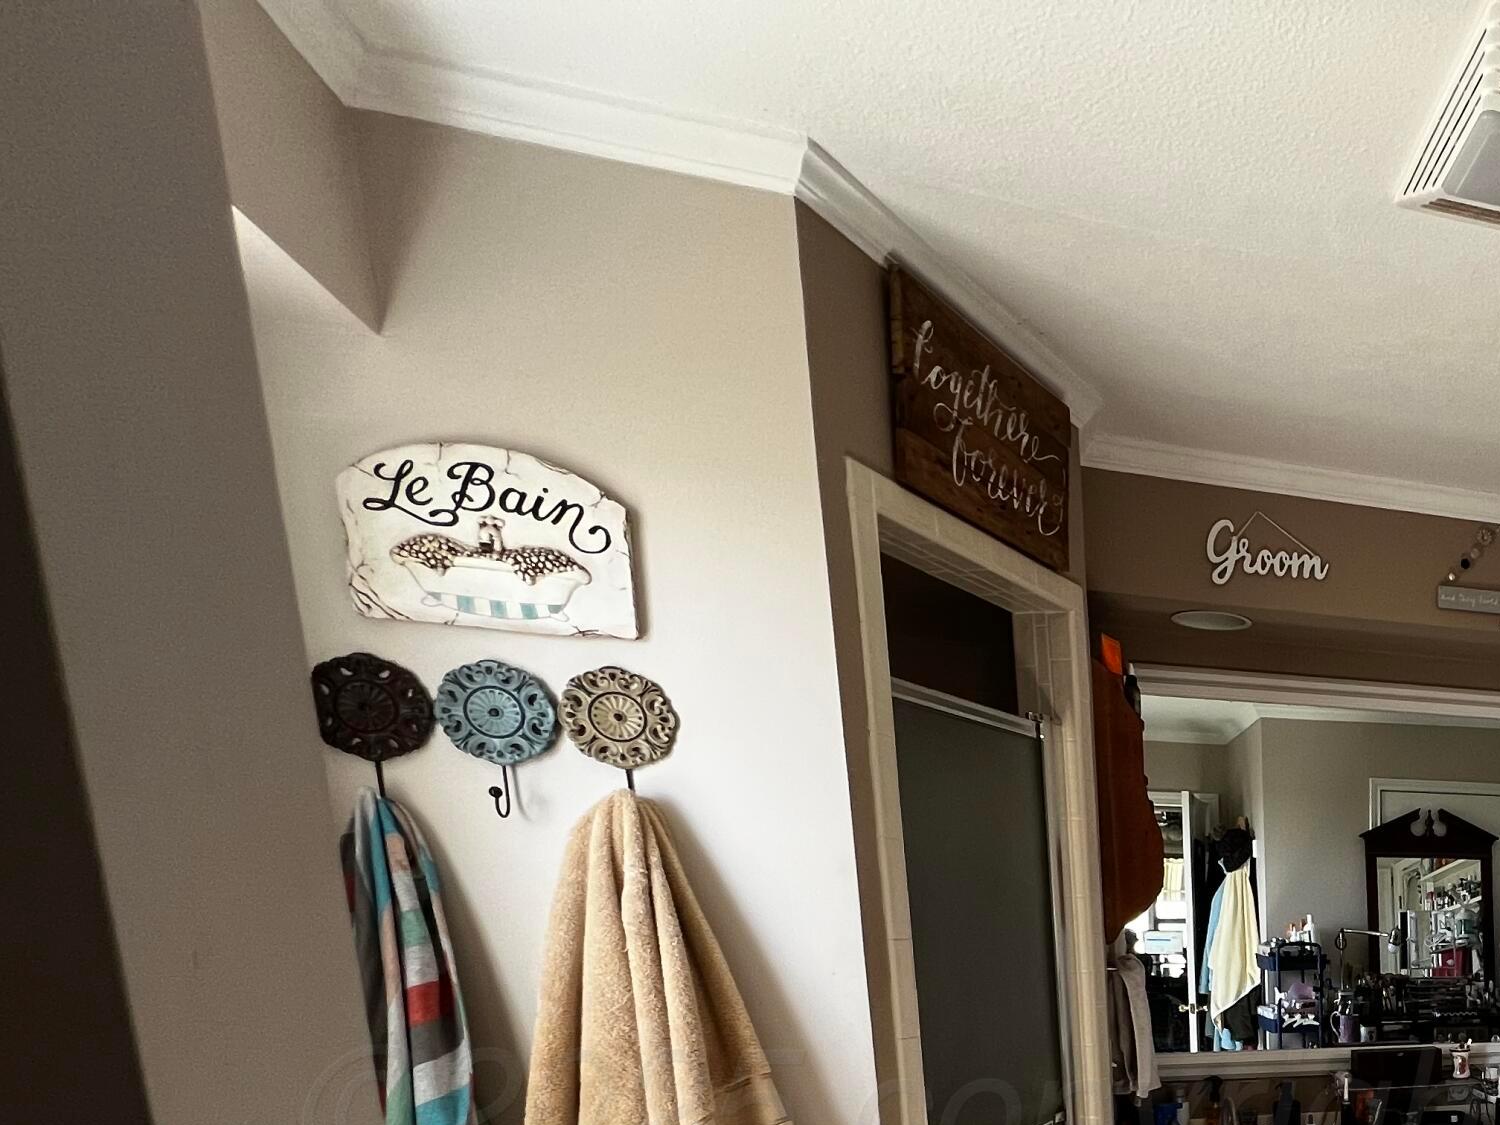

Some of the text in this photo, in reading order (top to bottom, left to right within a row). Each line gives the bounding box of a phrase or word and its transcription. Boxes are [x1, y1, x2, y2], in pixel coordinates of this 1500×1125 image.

[362, 459, 612, 554] Le Bain
[1206, 519, 1329, 585] Groom
